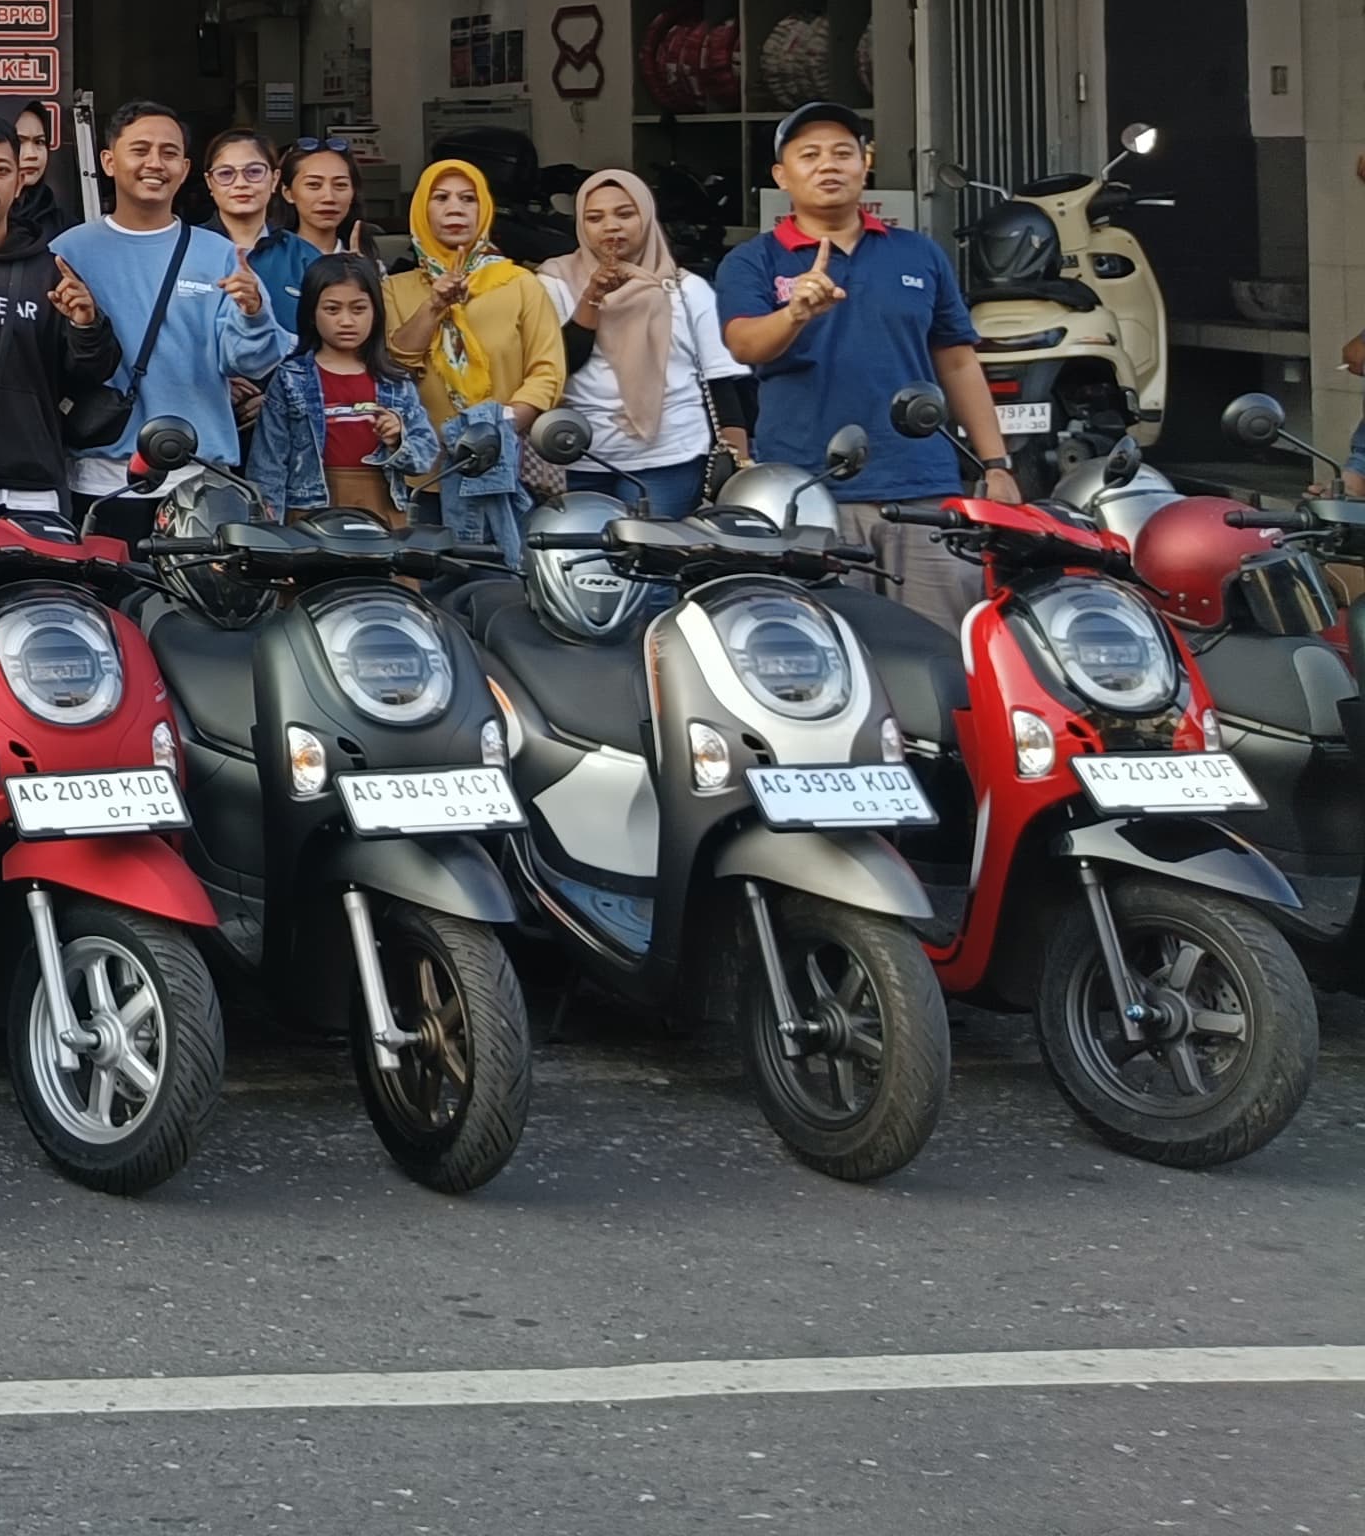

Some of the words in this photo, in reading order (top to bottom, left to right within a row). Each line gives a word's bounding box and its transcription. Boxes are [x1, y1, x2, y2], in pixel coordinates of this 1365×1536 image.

[760, 773, 794, 794] AG
[796, 771, 855, 792] 3938
[865, 770, 913, 791] KDD
[1090, 762, 1119, 782] AG
[1122, 760, 1183, 781] 2038
[1191, 760, 1234, 778] KDF
[17, 783, 50, 803] AG
[54, 779, 114, 800] 2038
[351, 780, 382, 801] AG
[386, 778, 448, 800] 3849
[453, 776, 503, 797] KCY
